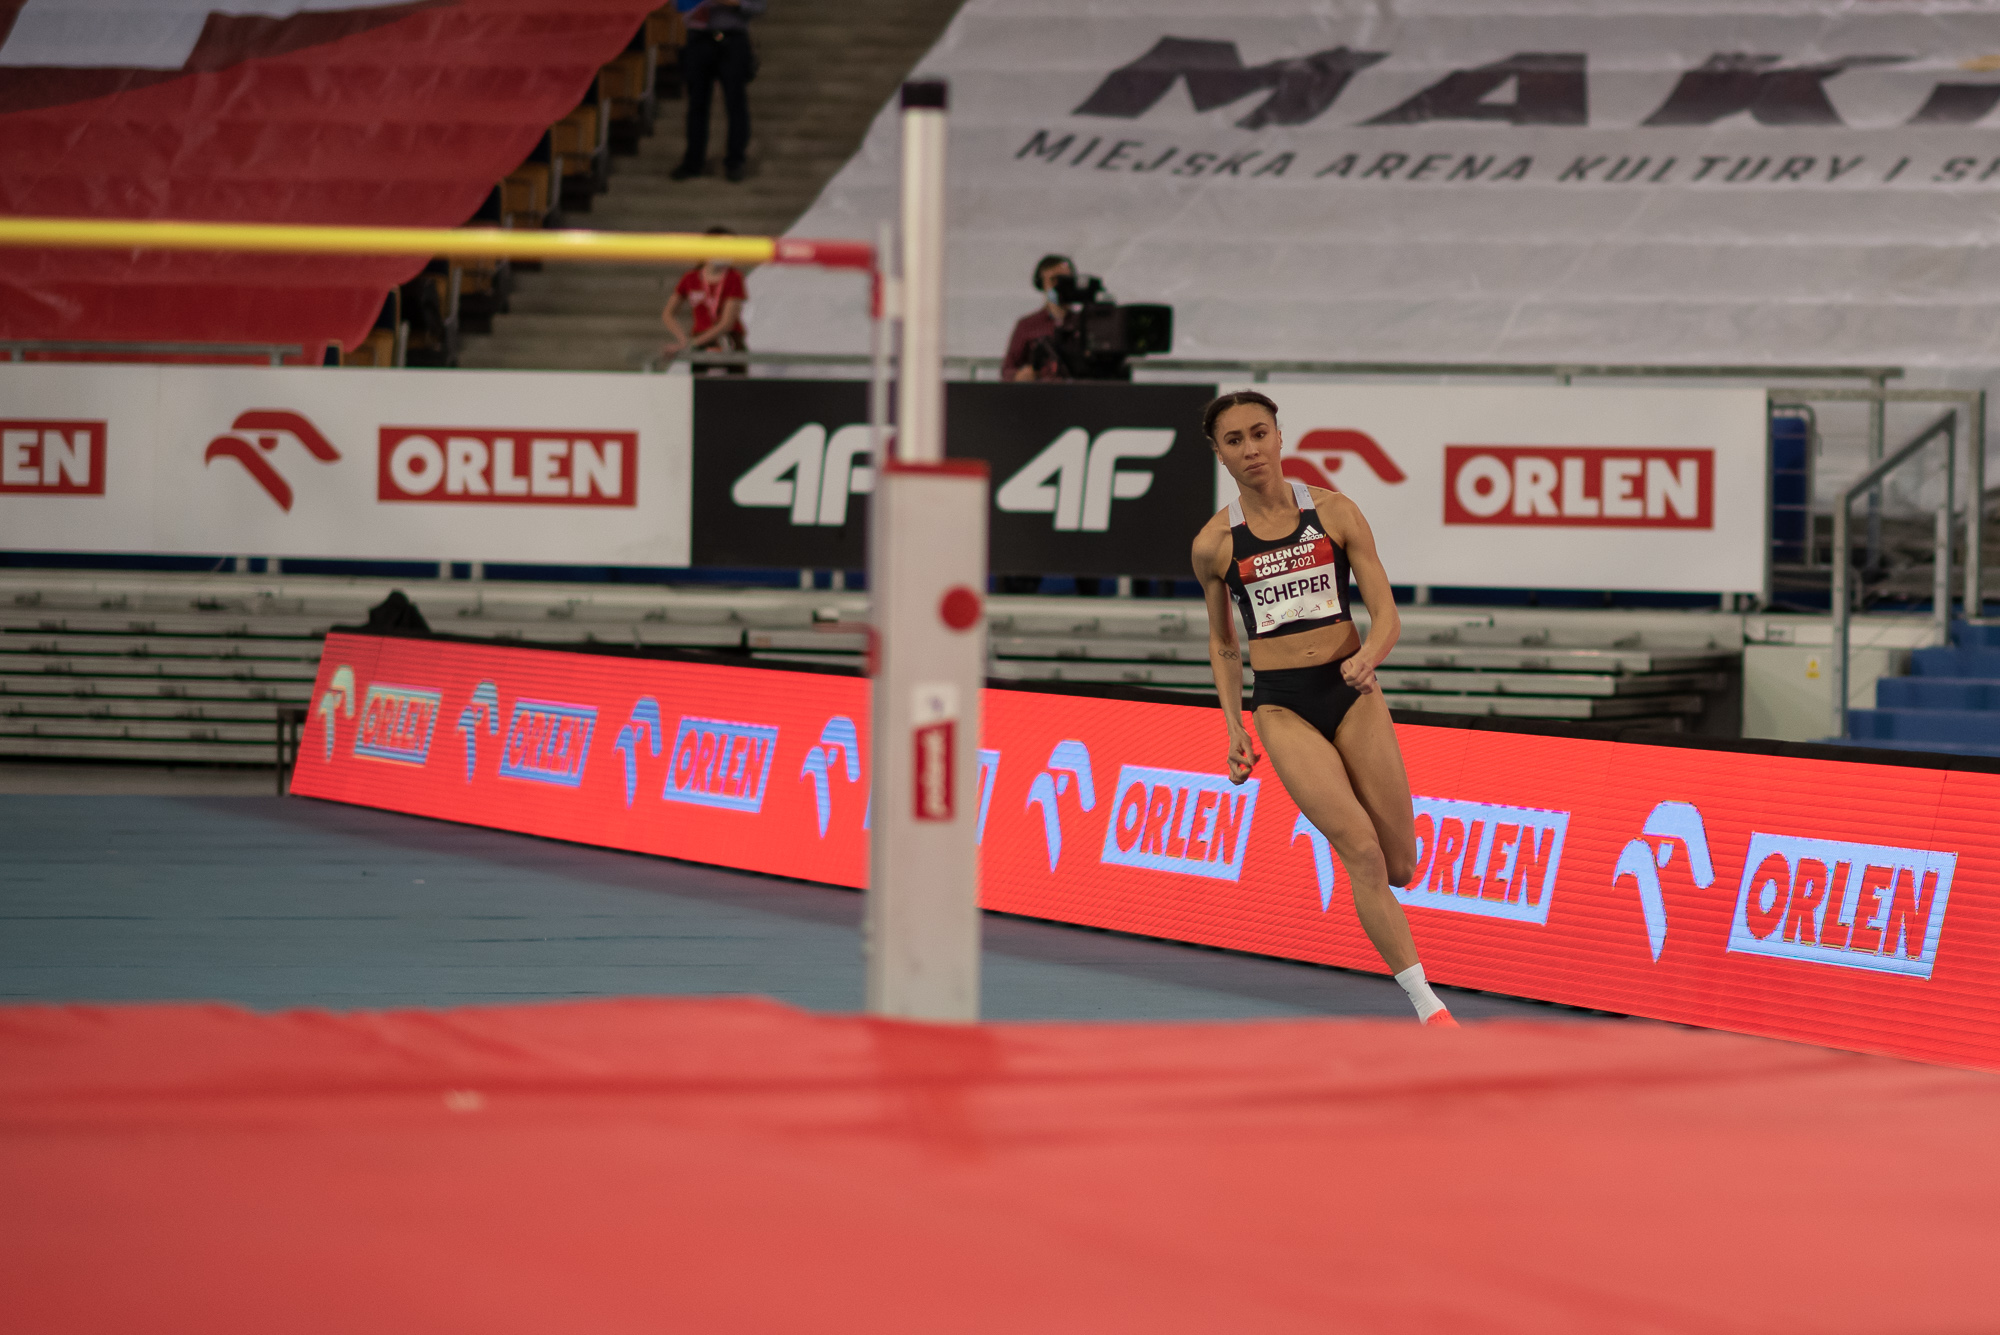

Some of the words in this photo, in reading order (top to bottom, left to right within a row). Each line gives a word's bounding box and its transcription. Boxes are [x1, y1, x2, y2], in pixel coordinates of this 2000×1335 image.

[1014, 129, 1298, 178] MIEJSKA
[1313, 152, 1534, 183] ARENA
[1558, 155, 1865, 183] KULTURY
[1883, 156, 1910, 183] I
[390, 434, 623, 499] ORLEN
[732, 423, 880, 526] 4F
[996, 426, 1177, 531] 4F
[1455, 455, 1699, 520] ORLEN
[1253, 548, 1292, 566] ORLEN
[1293, 543, 1315, 556] CUP
[1290, 555, 1316, 569] 2021
[1299, 533, 1324, 543] adidas
[1254, 573, 1331, 606] SCHEPER
[362, 693, 437, 756] ORLEN
[508, 710, 590, 777] ORLEN
[674, 729, 769, 801] ORLEN
[1115, 780, 1247, 866] ORLEN
[1746, 851, 1940, 960] ORLEN
